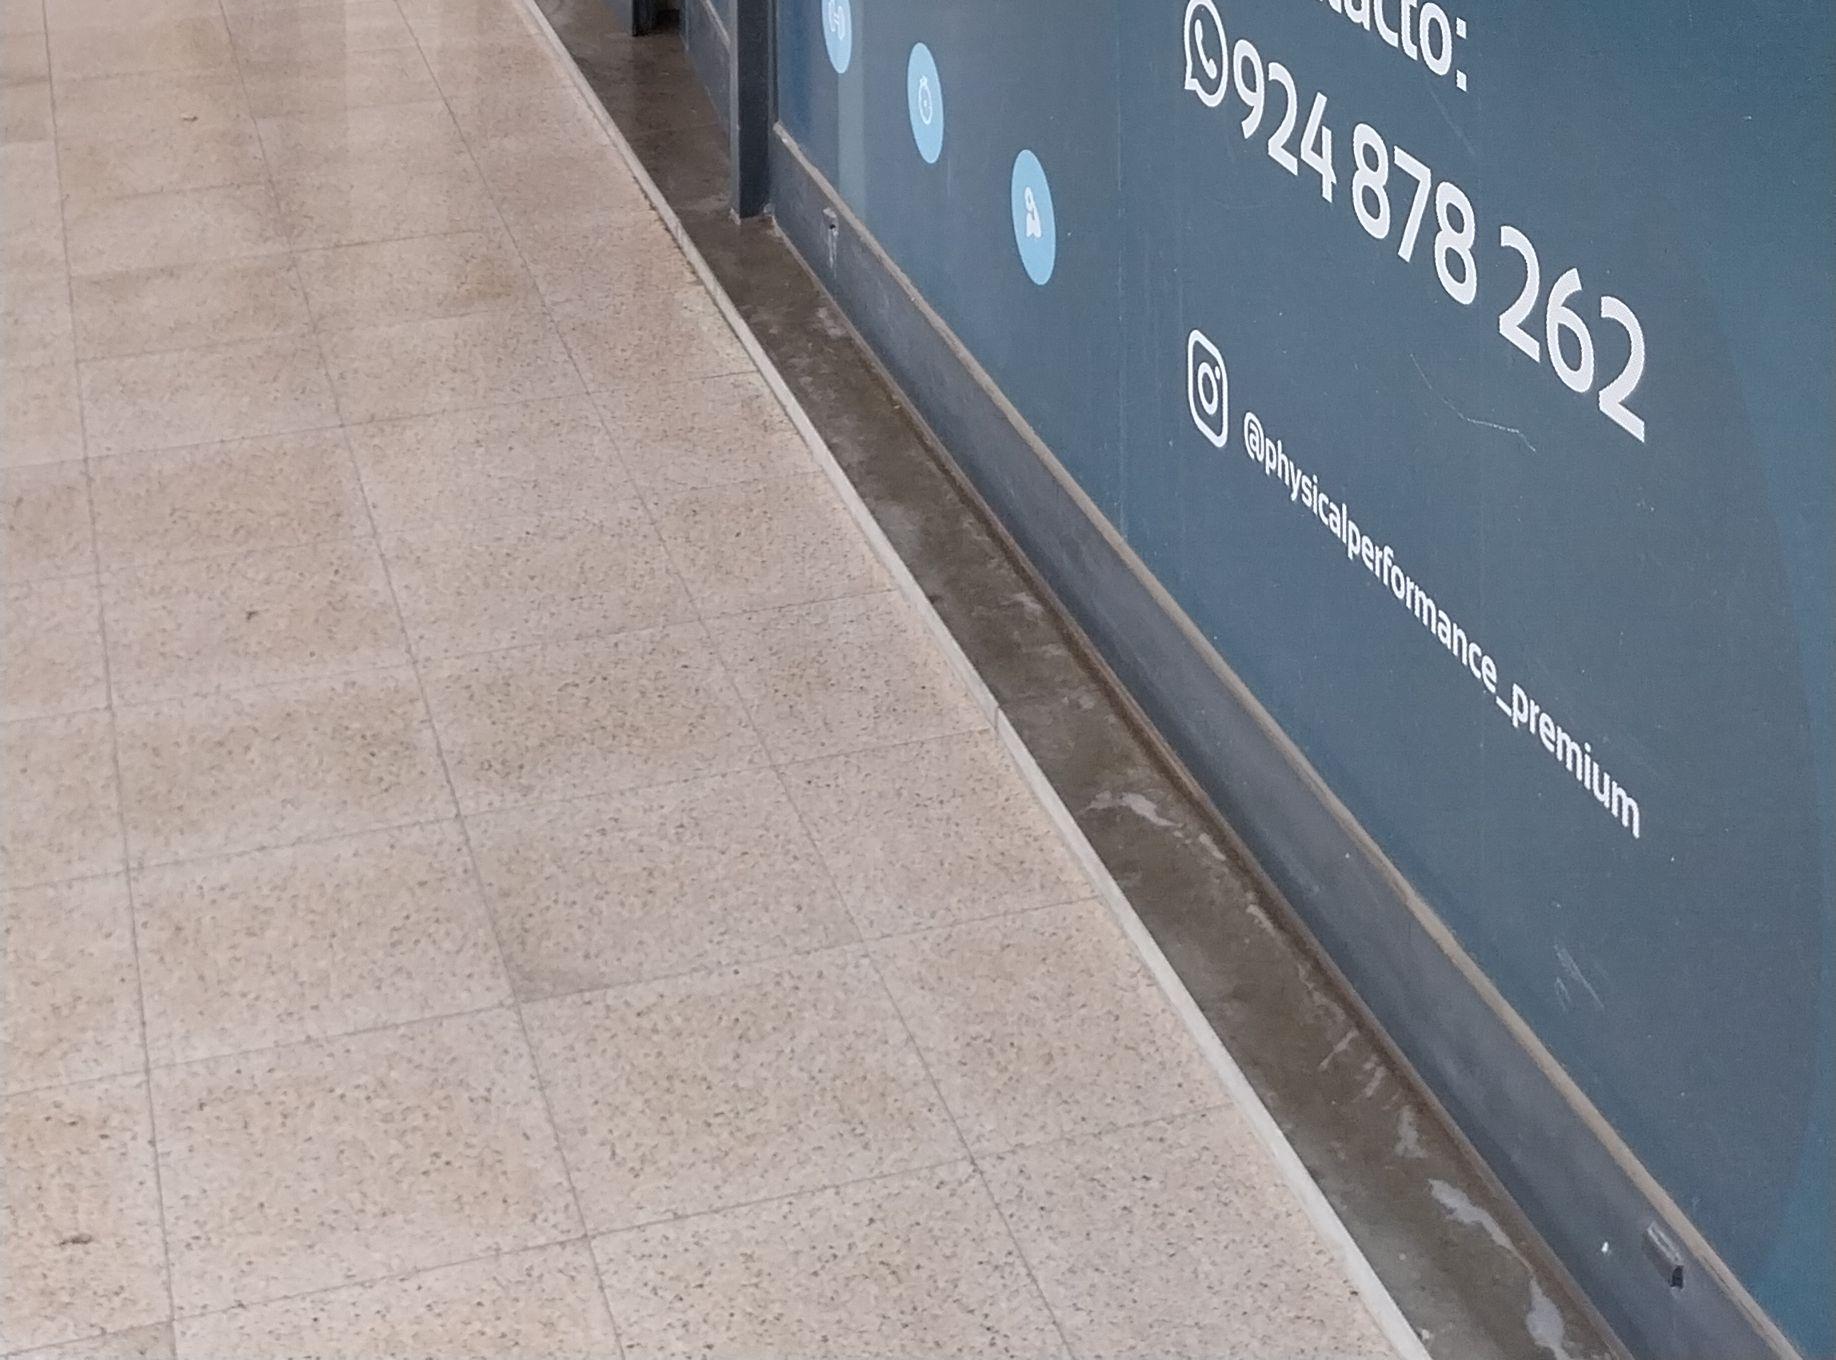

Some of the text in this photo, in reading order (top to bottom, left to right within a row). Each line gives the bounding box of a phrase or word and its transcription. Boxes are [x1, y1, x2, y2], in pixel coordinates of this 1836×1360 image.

[1233, 39, 1645, 443] 924 878 262
[1243, 411, 1641, 839] @physicalperformance_premium
